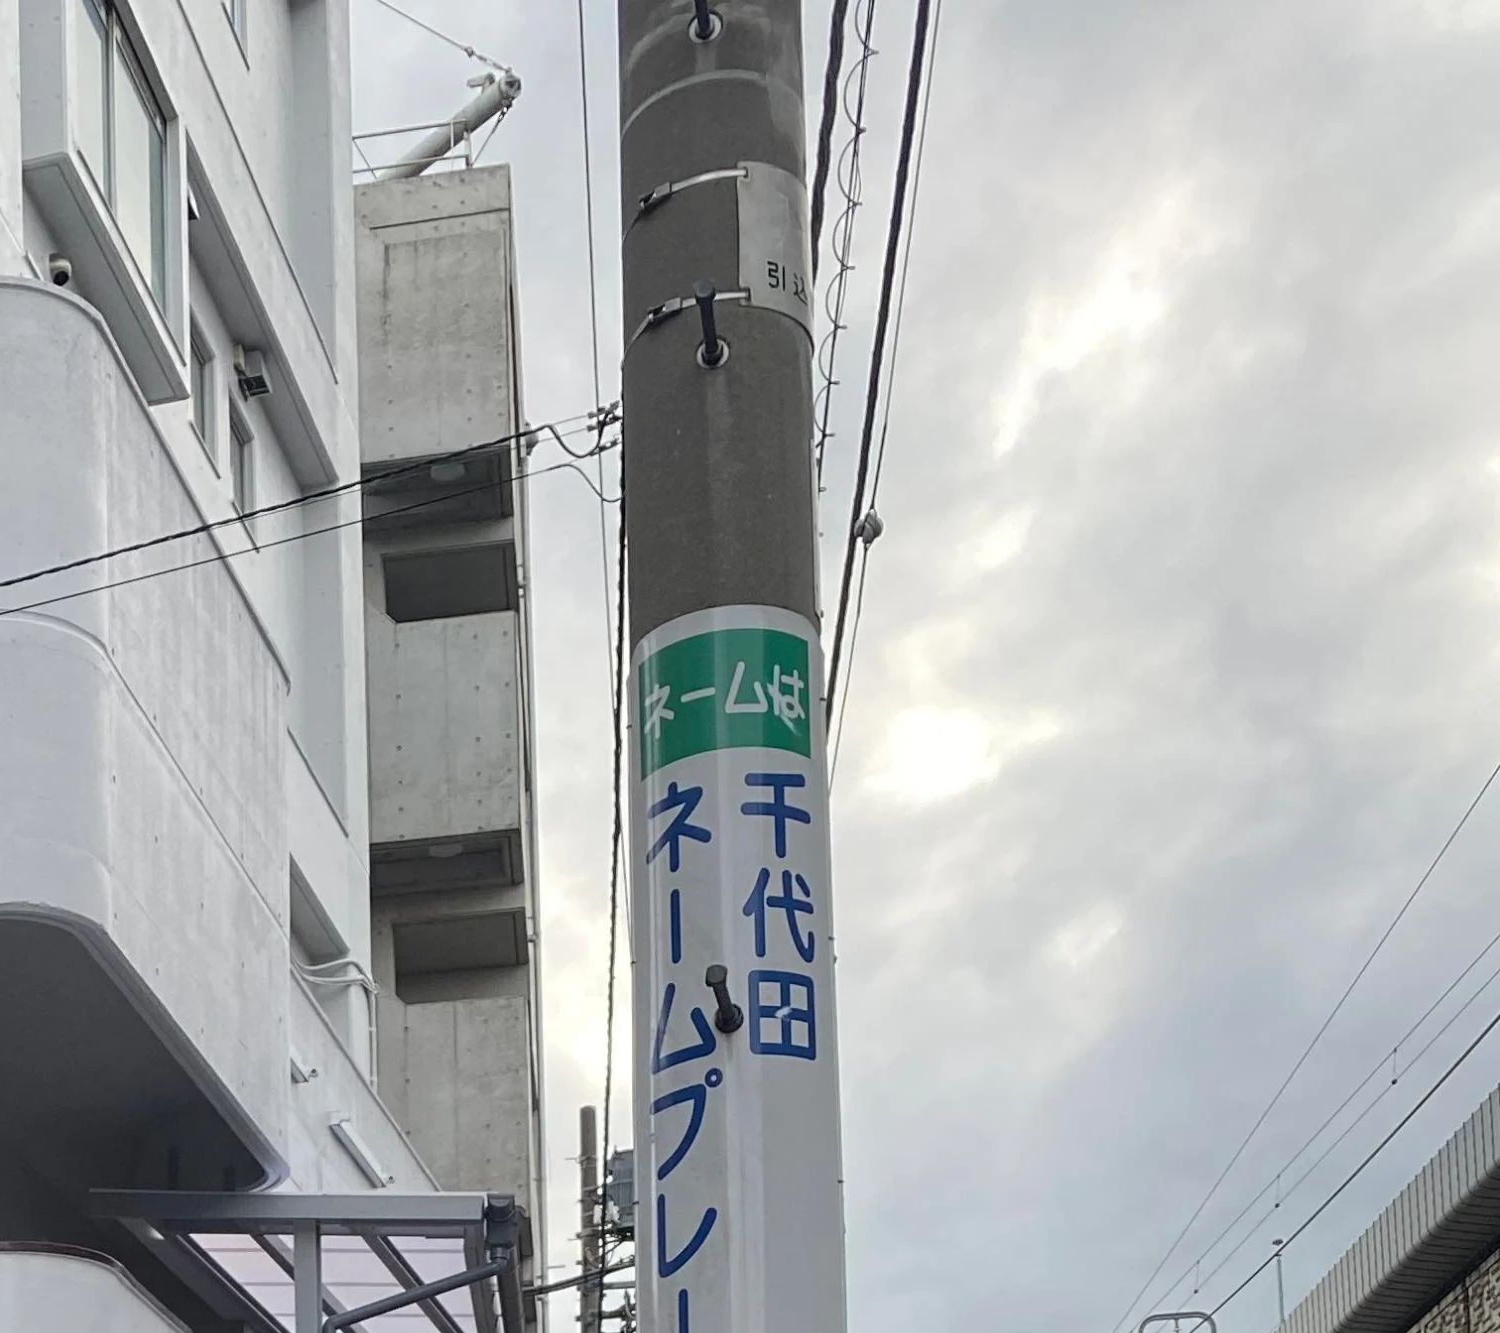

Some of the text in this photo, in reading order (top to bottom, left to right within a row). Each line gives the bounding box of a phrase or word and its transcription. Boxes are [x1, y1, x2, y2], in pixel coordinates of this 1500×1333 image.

[644, 661, 806, 739] ネームは
[741, 772, 817, 1061] 千代田
